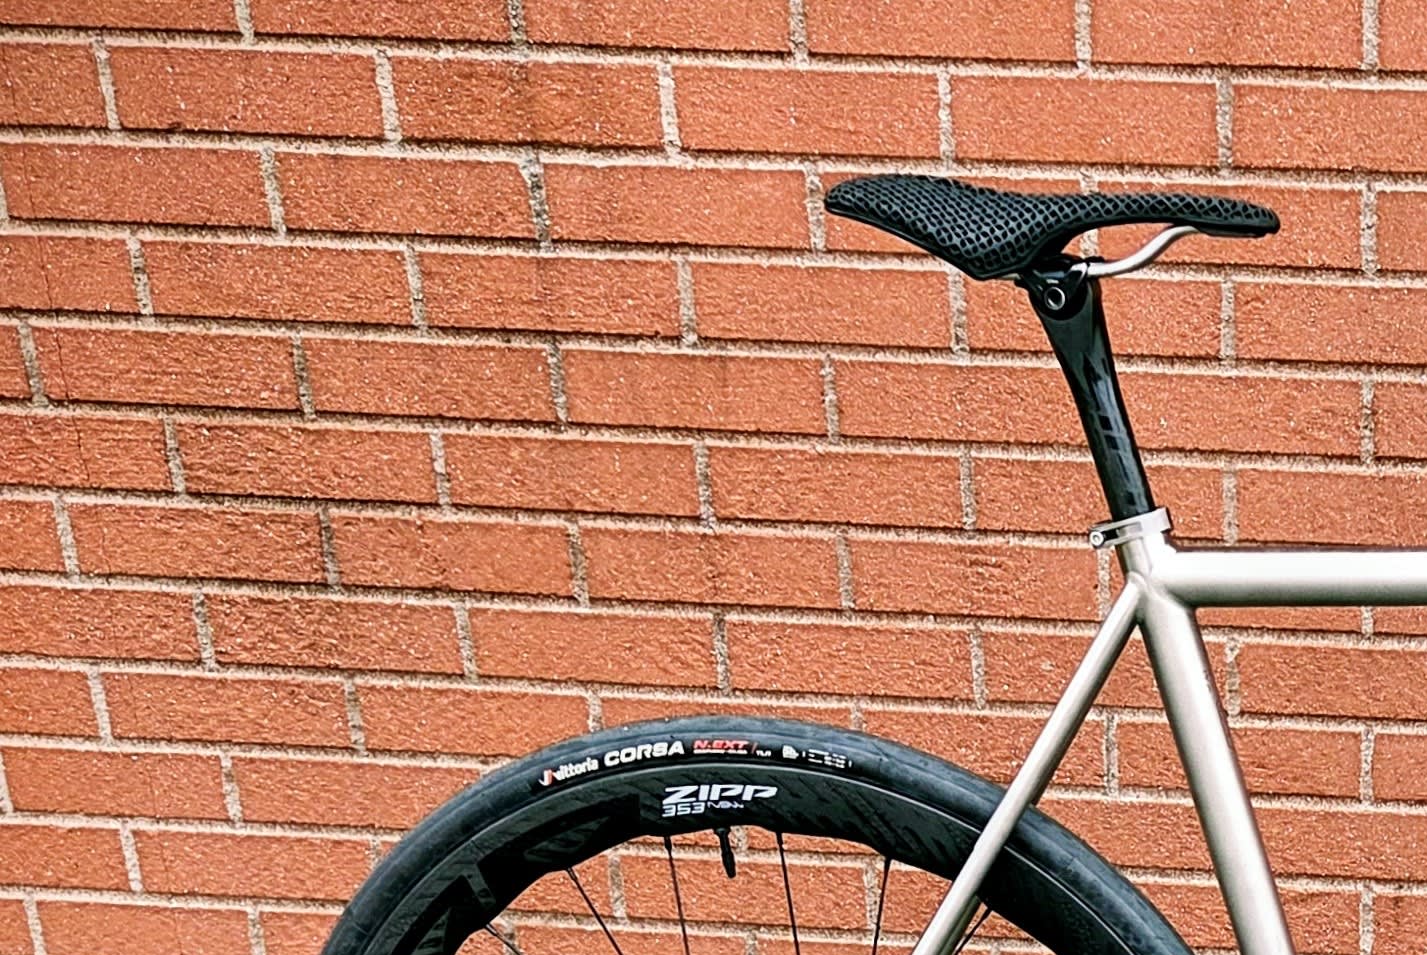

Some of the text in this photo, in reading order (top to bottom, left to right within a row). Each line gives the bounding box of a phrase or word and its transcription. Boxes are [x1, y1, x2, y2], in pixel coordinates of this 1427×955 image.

[604, 740, 685, 767] CORSA
[662, 784, 778, 805] ZIPP
[661, 801, 705, 817] 353
